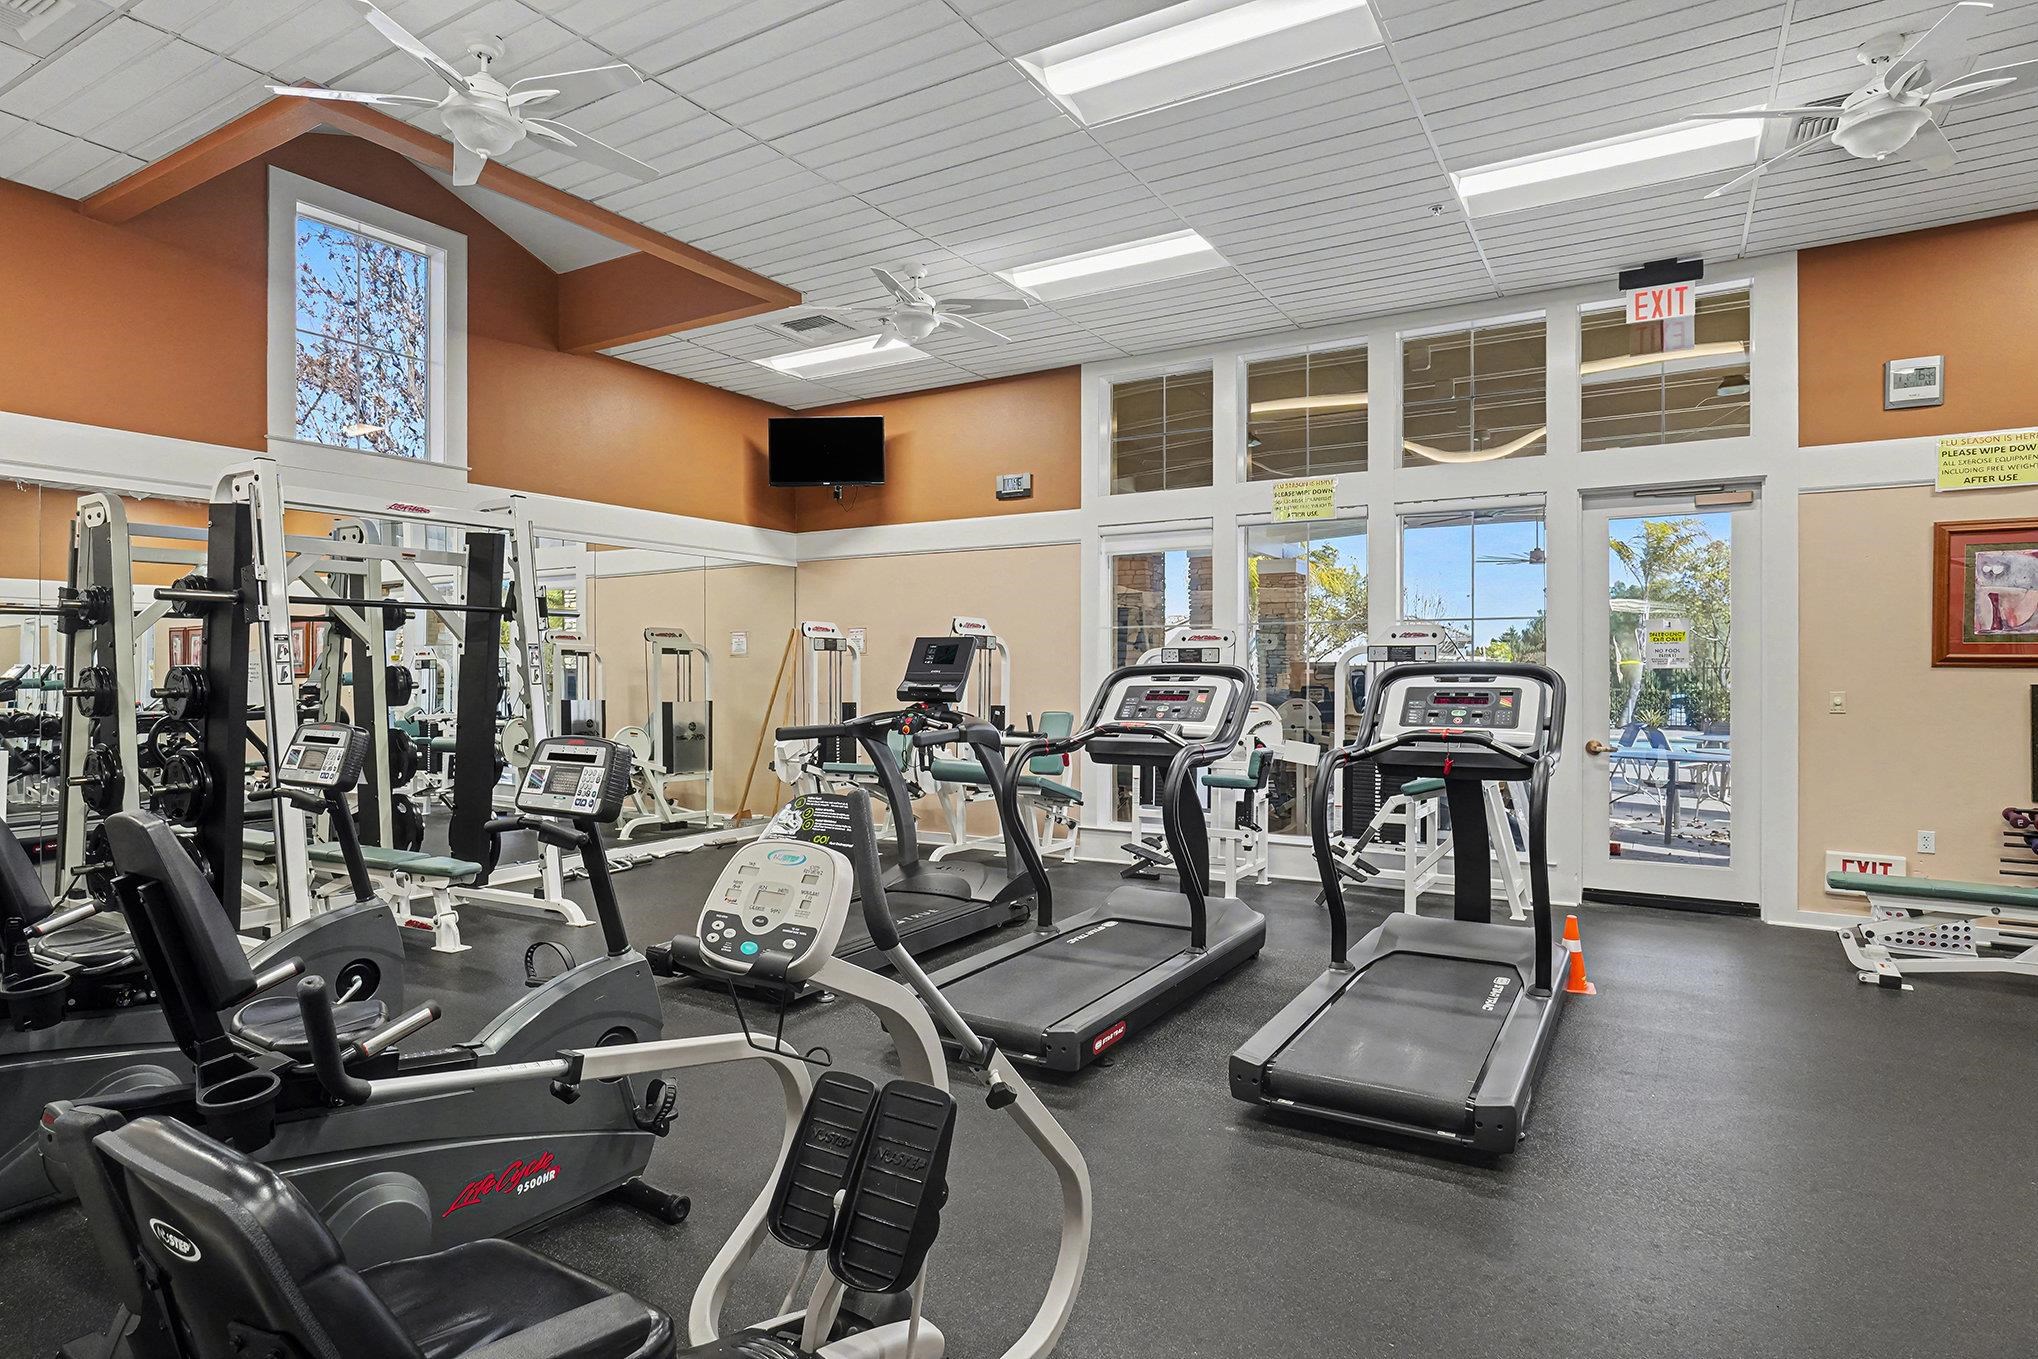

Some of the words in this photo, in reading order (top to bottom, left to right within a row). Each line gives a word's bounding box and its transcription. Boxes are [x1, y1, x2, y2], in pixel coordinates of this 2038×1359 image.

[1634, 286, 1688, 321] EXIT
[1961, 435, 2000, 446] SEASON
[1941, 448, 1977, 458] PLEASE
[1980, 445, 2006, 455] WIPE
[2009, 443, 2037, 453] DOW
[1942, 459, 1956, 467] ALL
[1995, 454, 2038, 463] EQUIPMEN
[1963, 475, 1995, 484] AFTER
[1998, 473, 2019, 482] USE
[813, 835, 830, 844] GO!
[516, 1169, 556, 1196] 9500HR
